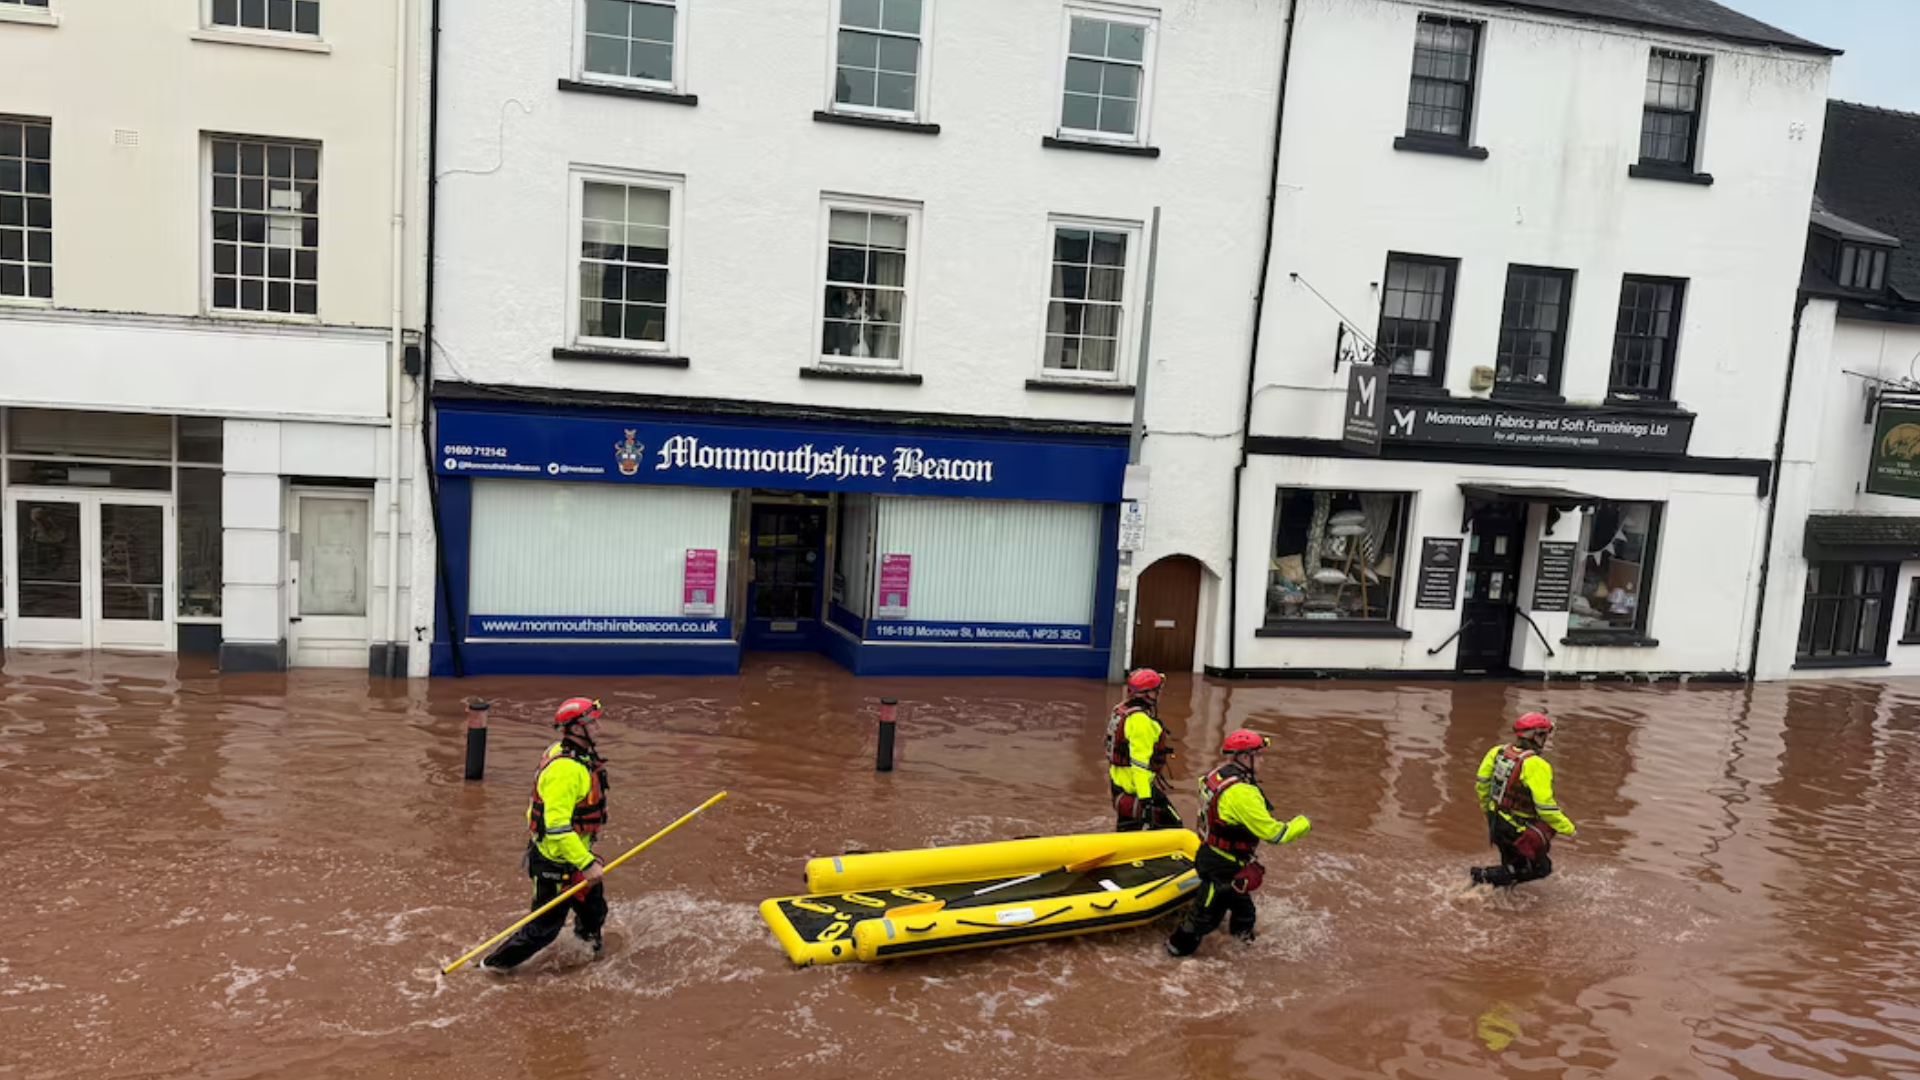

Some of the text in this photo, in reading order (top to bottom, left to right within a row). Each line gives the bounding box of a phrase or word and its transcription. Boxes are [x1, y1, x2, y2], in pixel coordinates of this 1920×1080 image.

[1425, 410, 1669, 438] Monmouth Fabrics and Soft Furnishings Ltd
[1494, 431, 1506, 440] For
[1506, 432, 1516, 441] all
[1516, 434, 1532, 443] your
[1532, 434, 1545, 443] soft
[1546, 435, 1579, 446] furnishing
[444, 445, 508, 457] 01600 712142
[656, 435, 994, 482] Monmouthshire Beacon
[482, 619, 718, 633] www.monmouthshirebeacon.co.uk
[876, 625, 1082, 640] 116-118 Monnow St, Monmouth, NP25 3EQ
